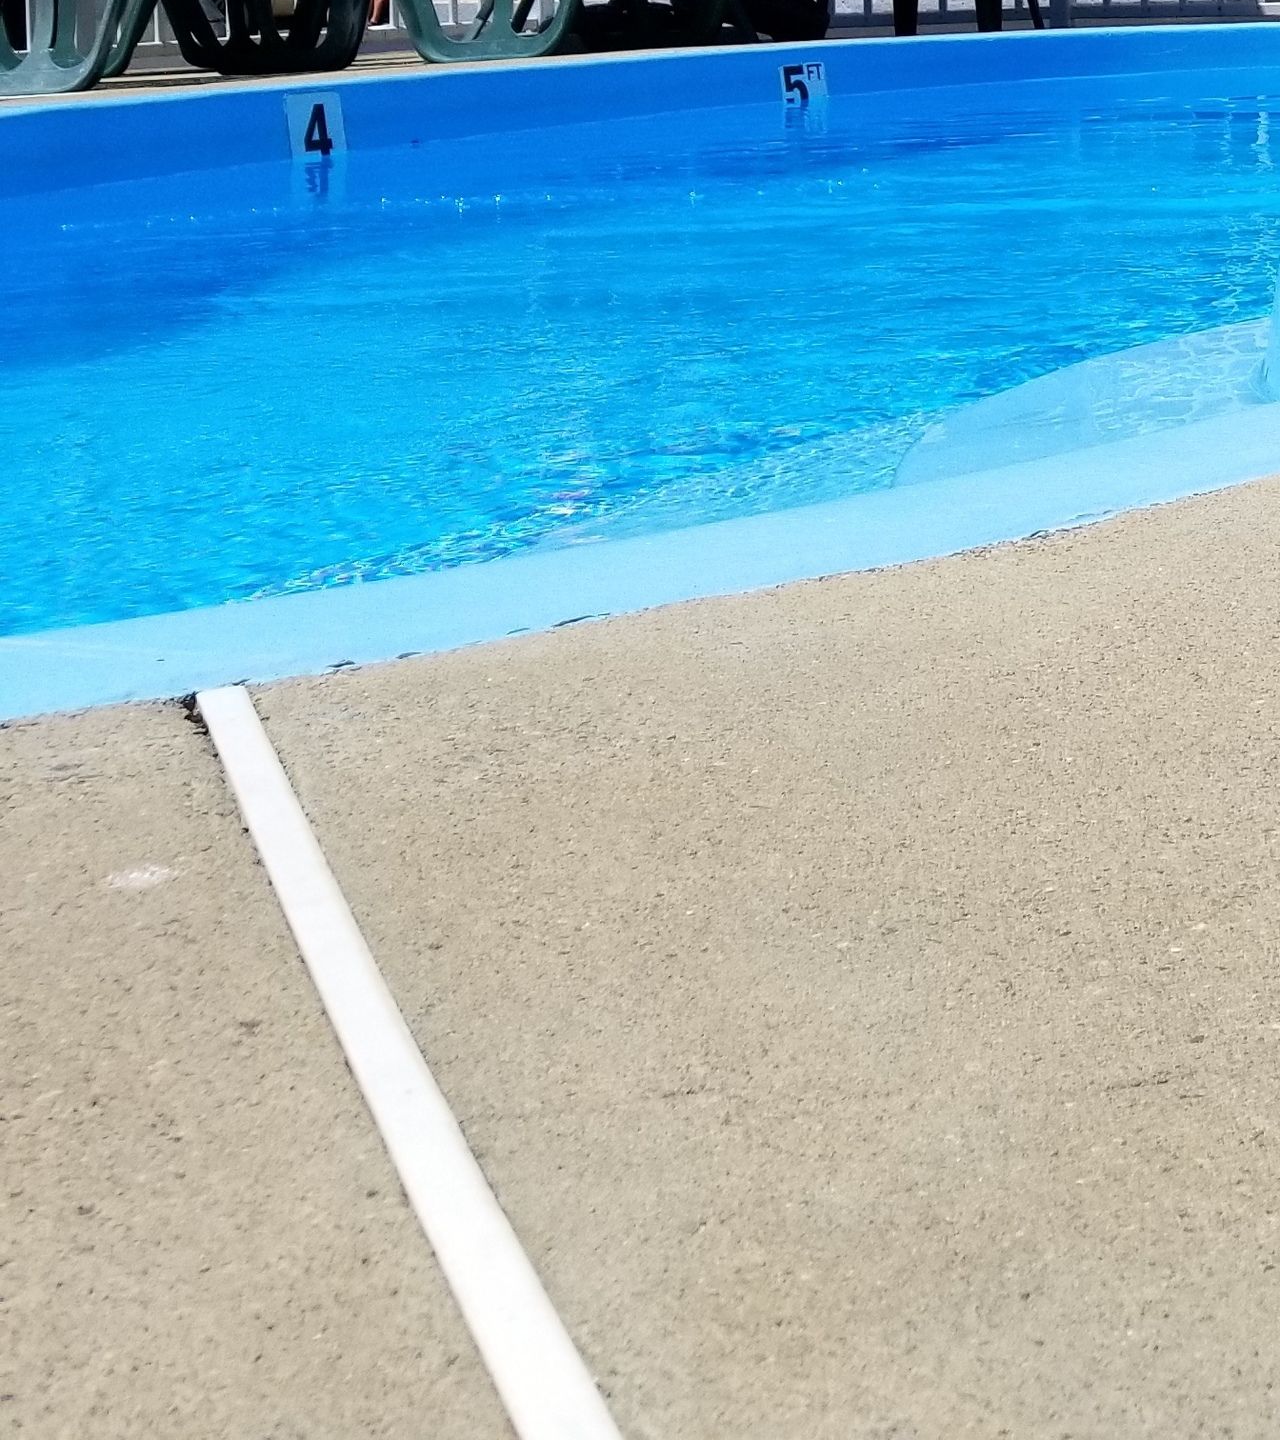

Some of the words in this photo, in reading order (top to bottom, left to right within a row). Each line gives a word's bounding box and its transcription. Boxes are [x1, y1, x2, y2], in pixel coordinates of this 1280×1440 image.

[783, 64, 809, 107] 5
[807, 64, 822, 80] FT
[304, 103, 333, 156] 4
